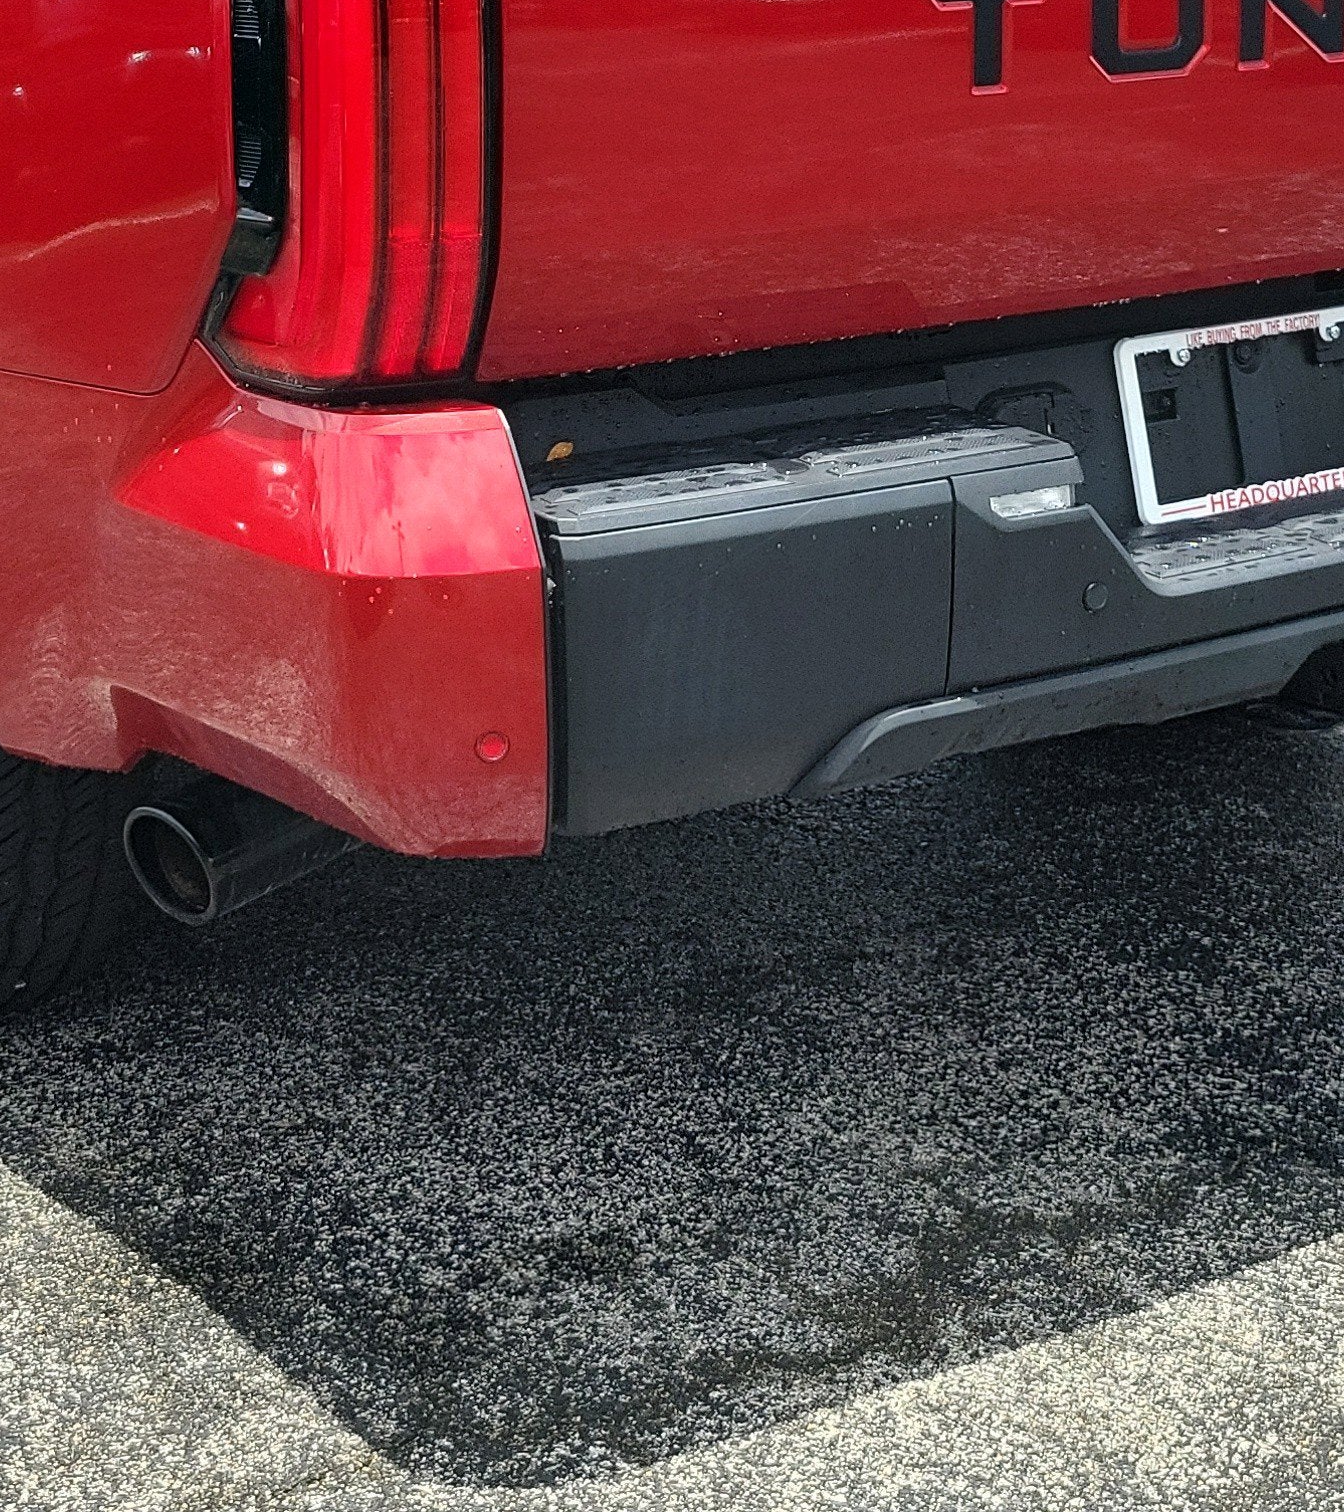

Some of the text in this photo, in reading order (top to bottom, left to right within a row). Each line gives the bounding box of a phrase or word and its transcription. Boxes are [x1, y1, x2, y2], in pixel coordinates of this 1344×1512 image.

[1185, 331, 1203, 348] LIKE
[1206, 327, 1237, 345] BUYING
[1240, 322, 1263, 339] FROM
[1266, 319, 1281, 335] THE
